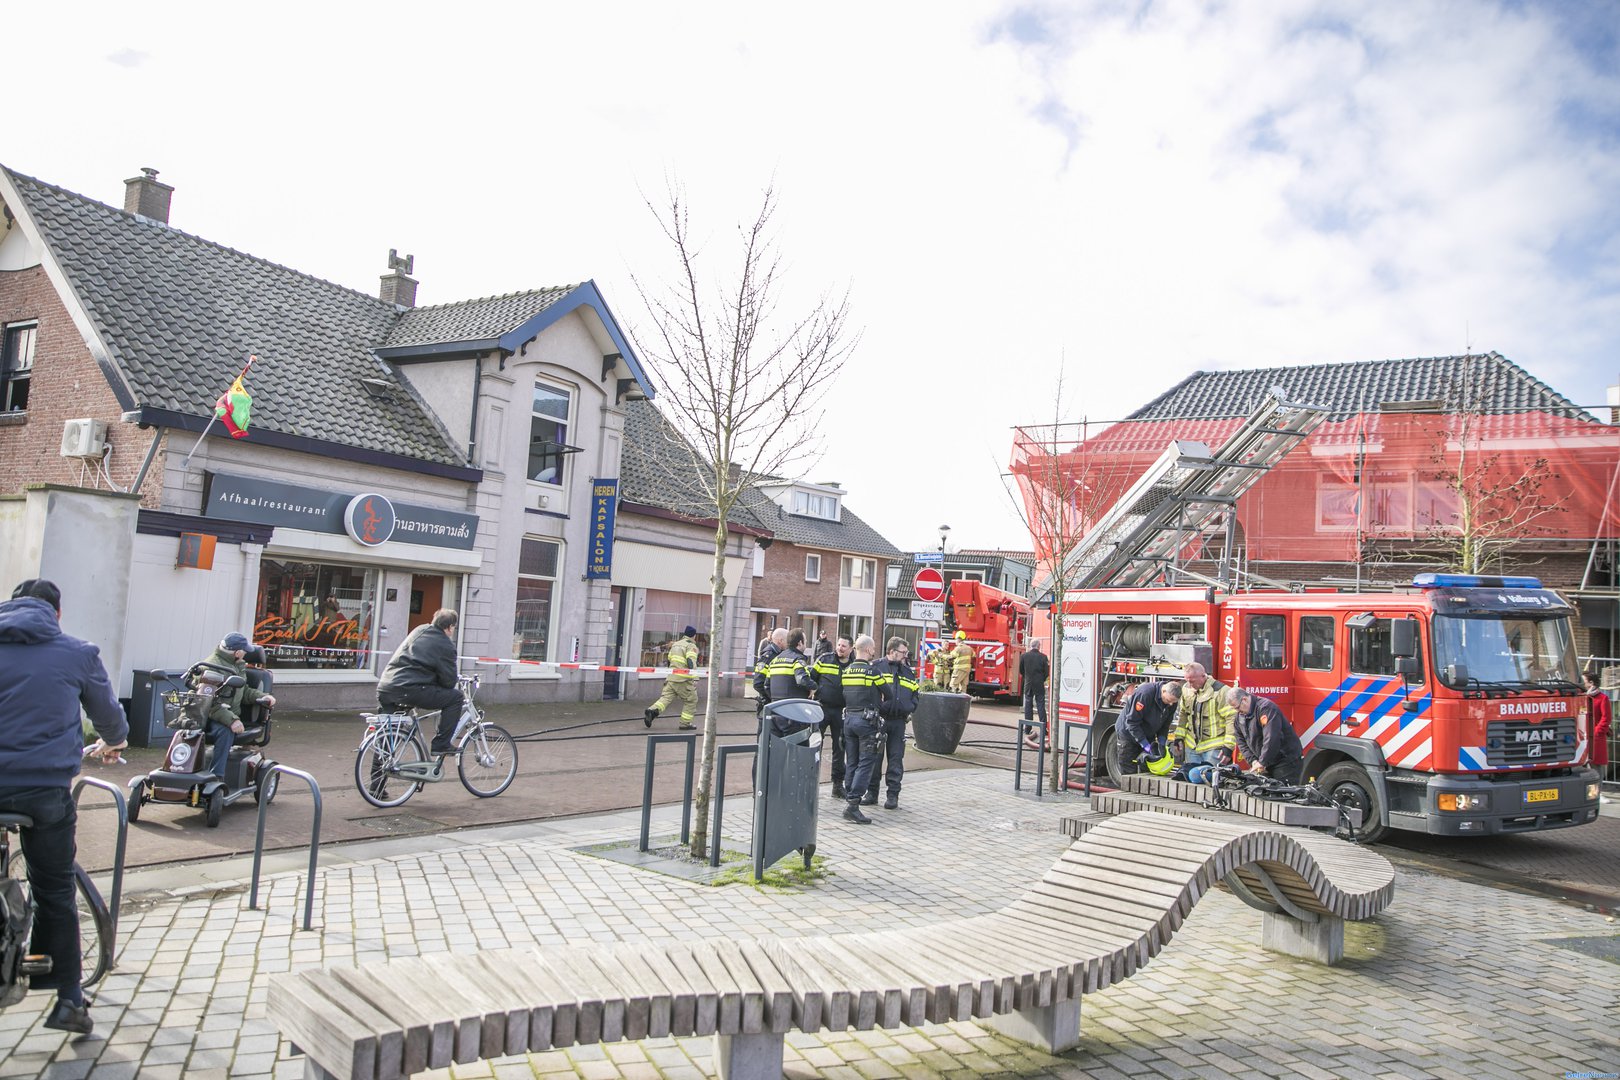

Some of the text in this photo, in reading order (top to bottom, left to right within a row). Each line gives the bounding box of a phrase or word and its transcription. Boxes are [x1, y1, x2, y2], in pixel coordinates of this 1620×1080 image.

[594, 485, 616, 497] HEREN
[219, 492, 327, 516] Afhaalrestaurant
[594, 498, 607, 564] KAPSALON
[1222, 615, 1235, 669] 07-4431
[1245, 686, 1289, 694] BRANDWEER
[1500, 701, 1567, 715] BRANDWEER
[1515, 729, 1555, 742] MAN
